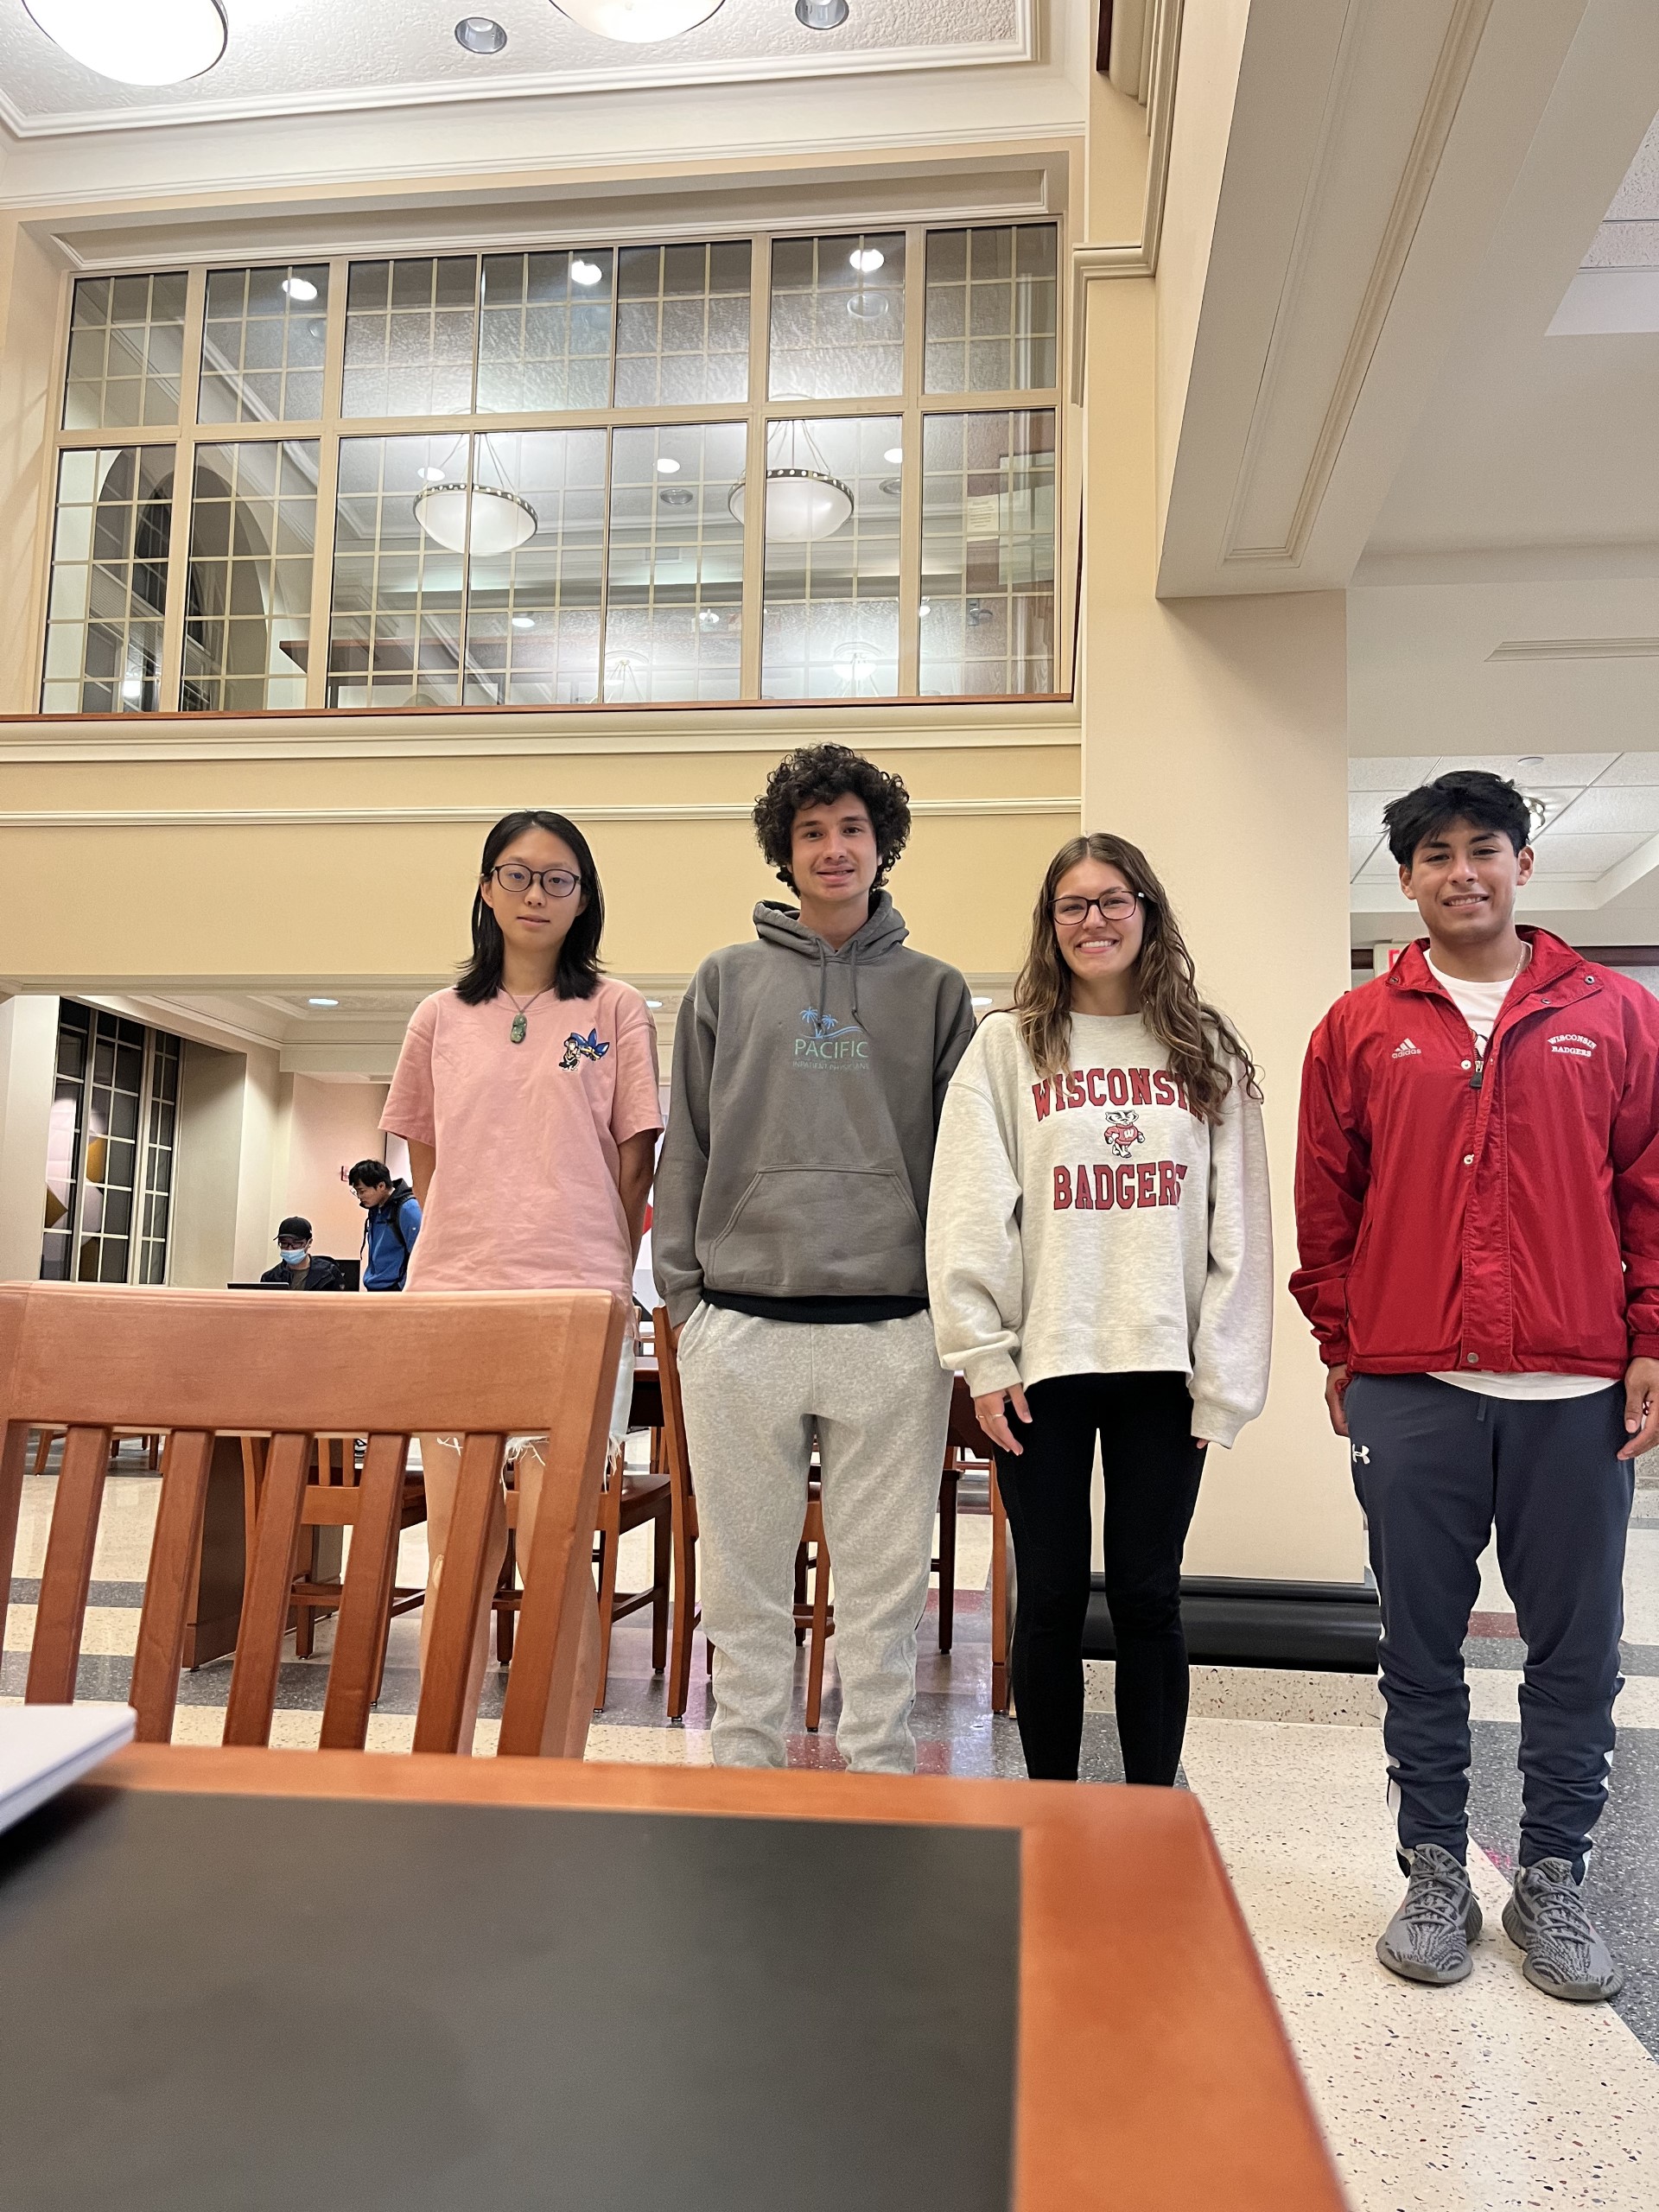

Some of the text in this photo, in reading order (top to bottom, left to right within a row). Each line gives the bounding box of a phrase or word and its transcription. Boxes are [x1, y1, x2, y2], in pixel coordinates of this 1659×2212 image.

[794, 1038, 869, 1059] PACIFIC
[1547, 1033, 1598, 1050] WISCONSIN
[1391, 1048, 1422, 1059] adidas
[1551, 1046, 1592, 1058] BADGERS
[1032, 1068, 1205, 1124] WISCONSI
